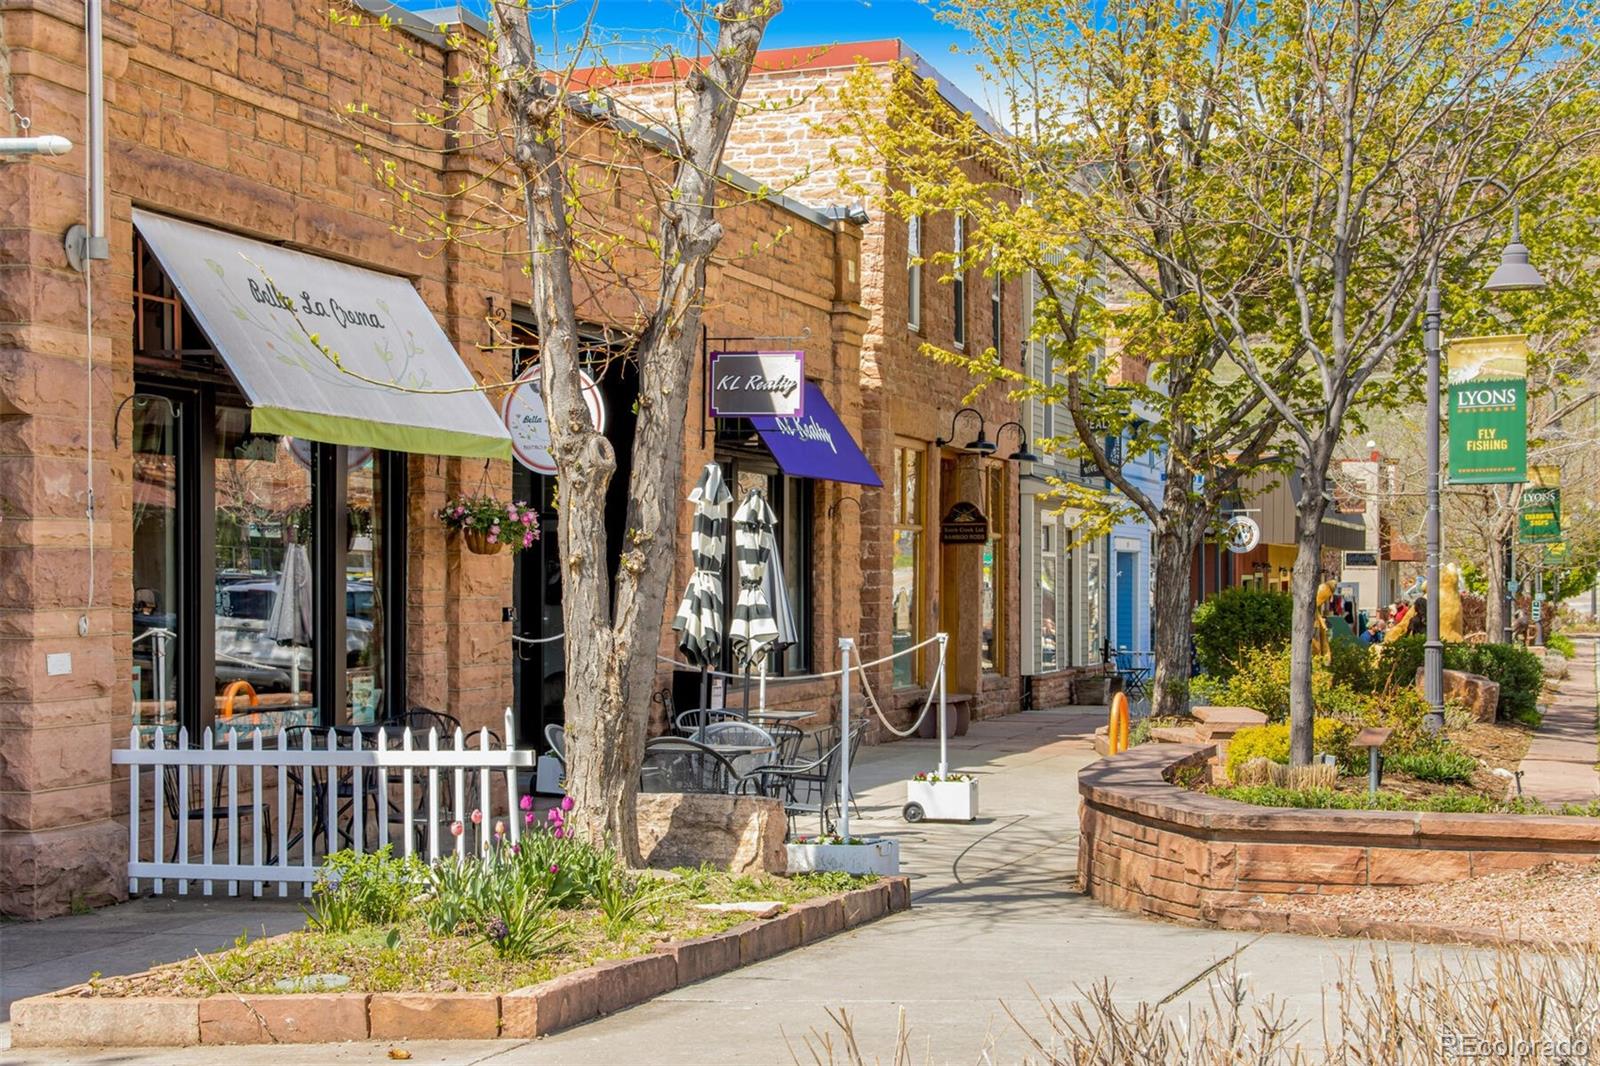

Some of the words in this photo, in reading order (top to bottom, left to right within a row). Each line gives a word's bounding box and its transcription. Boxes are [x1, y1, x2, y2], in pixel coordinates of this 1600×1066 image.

[300, 291, 331, 317] La
[329, 298, 385, 329] Crema
[716, 374, 741, 391] KL
[745, 374, 798, 400] Realty
[1458, 388, 1516, 406] LYONS
[522, 415, 542, 424] Bella
[793, 415, 838, 454] Realty
[1478, 428, 1496, 440] FLY
[1466, 439, 1508, 452] FISHING
[1523, 493, 1556, 502] LYONS
